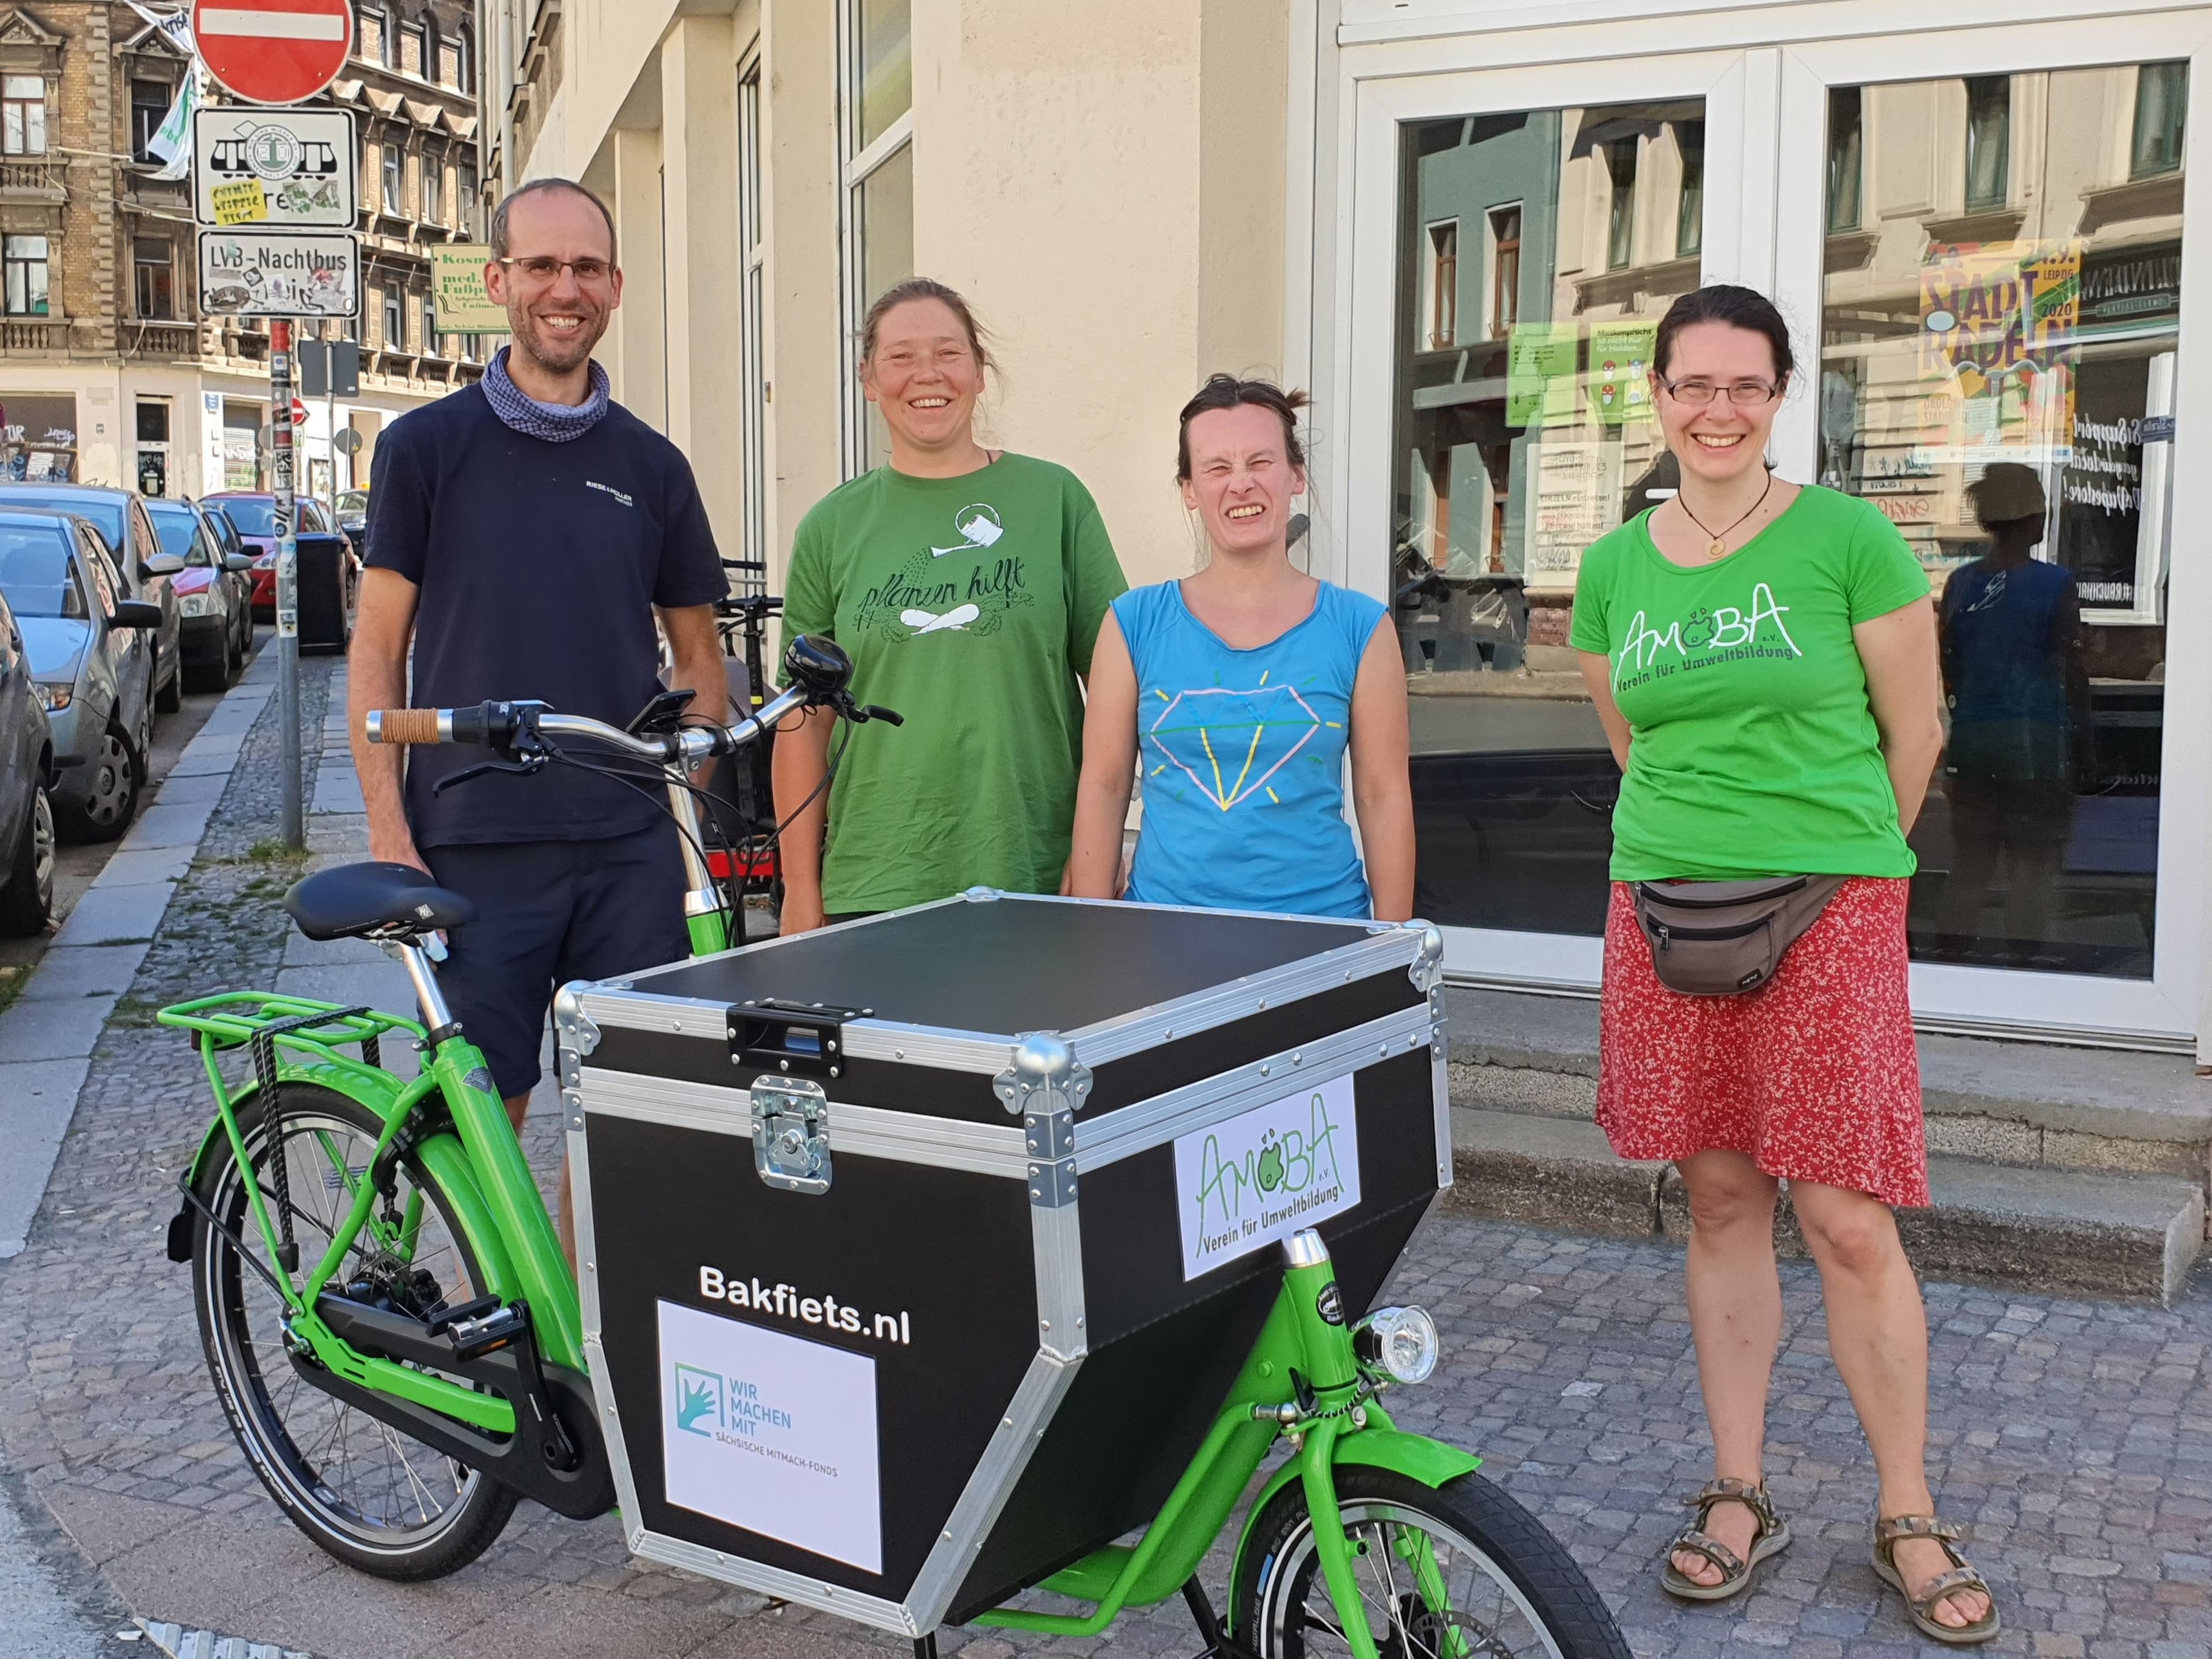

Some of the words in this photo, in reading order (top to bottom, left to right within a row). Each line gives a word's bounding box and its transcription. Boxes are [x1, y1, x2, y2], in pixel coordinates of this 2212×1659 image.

[211, 245, 347, 271] LVB-Nachtbus
[442, 254, 487, 264] Kosm
[2043, 268, 2073, 281] LEIPZIG
[2043, 302, 2072, 317] 2020
[586, 480, 606, 491] RIESE
[1616, 671, 1651, 693] Verein
[1656, 664, 1676, 679] für
[1682, 645, 1794, 672] Umweltbildung
[1203, 1226, 1239, 1255] Verein
[1241, 1217, 1258, 1238] für
[1261, 1185, 1339, 1229] Umweltbildung
[699, 1265, 910, 1344] Bakfiets.nl
[729, 1377, 758, 1401] WIR
[730, 1396, 792, 1430] MACHEN
[731, 1415, 757, 1437] MIT
[715, 1431, 765, 1456] SÄCHSISCHE
[766, 1447, 839, 1478] MITMACH-FONDS
